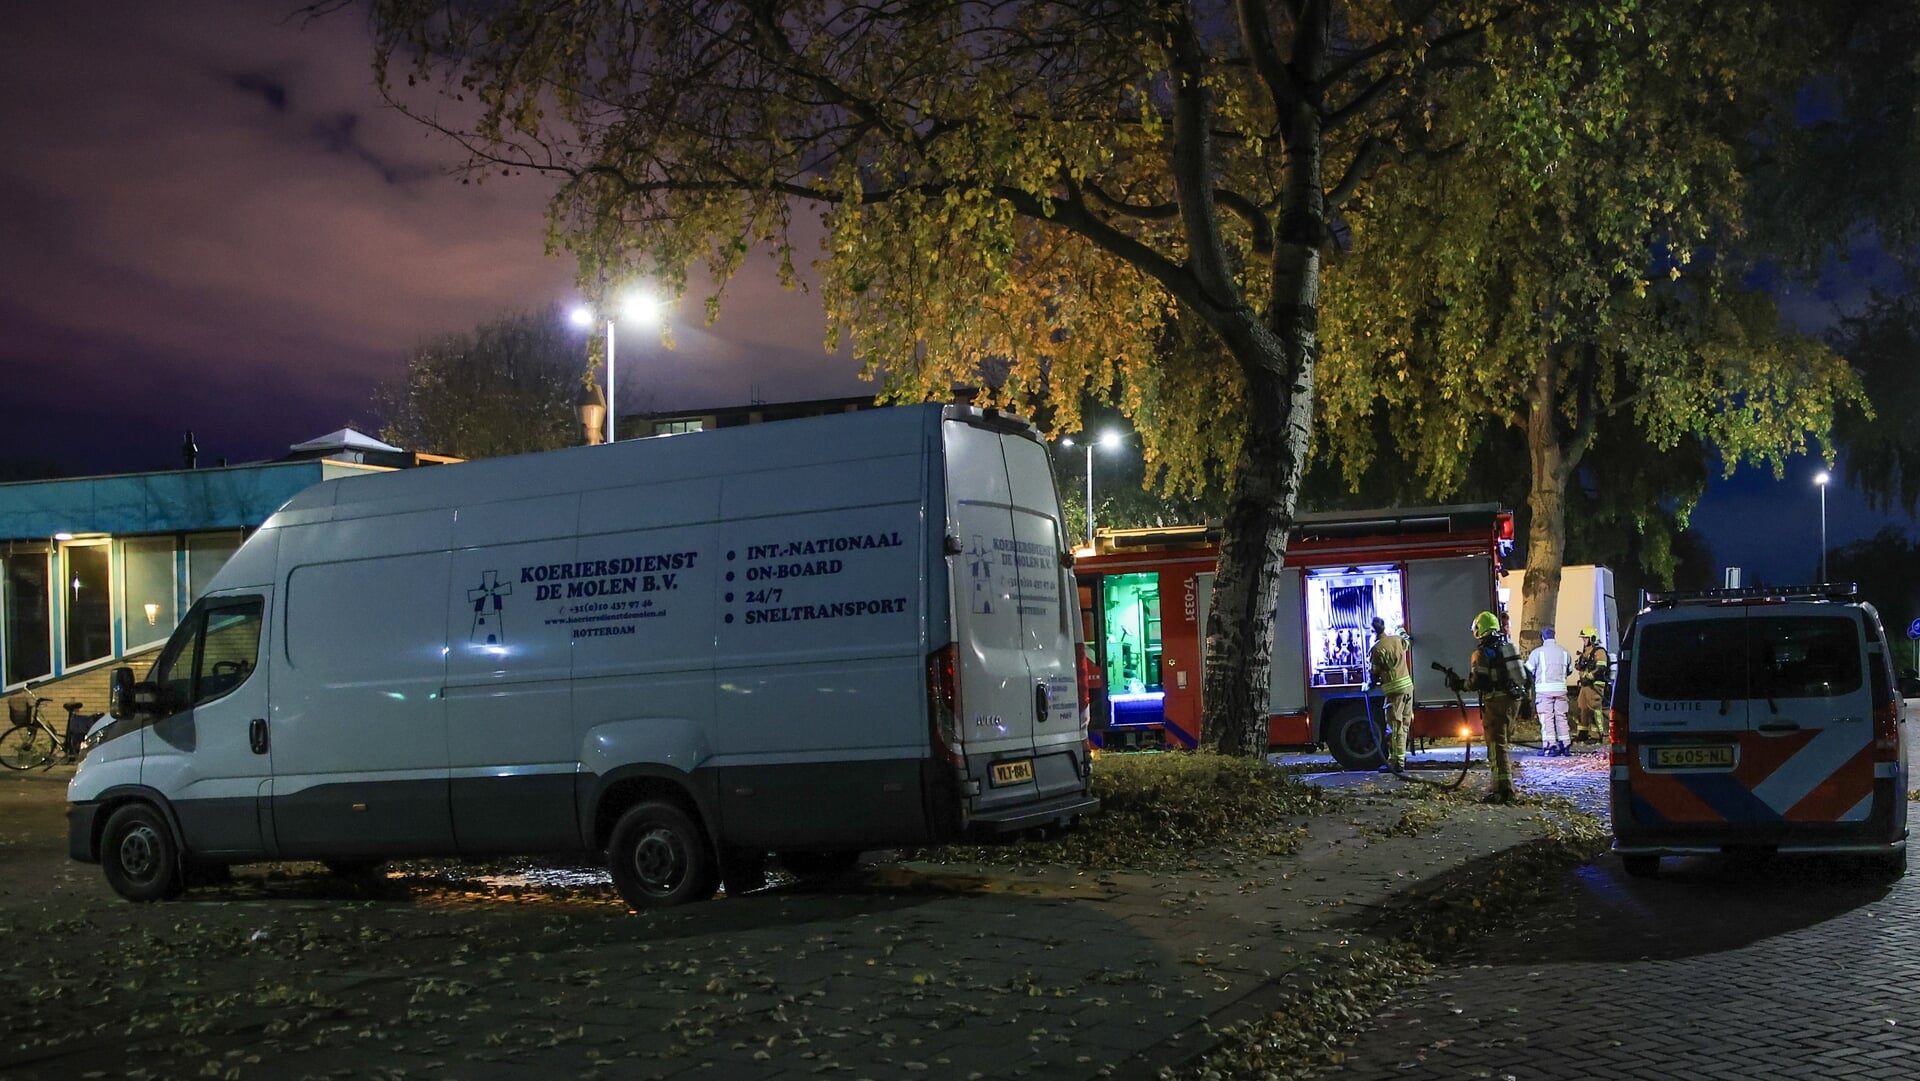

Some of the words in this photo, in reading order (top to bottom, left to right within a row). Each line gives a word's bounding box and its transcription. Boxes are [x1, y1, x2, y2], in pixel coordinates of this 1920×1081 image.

[747, 532, 903, 560] INT.-NATIONAAL
[520, 551, 698, 584] KOERIERSDIENST
[746, 560, 843, 581] ON-BOARD
[535, 583, 562, 601] DE
[567, 577, 637, 599] MOLEN
[642, 574, 678, 592] B.V.
[745, 587, 783, 604] 24/7
[1184, 577, 1196, 621] 17-0331
[745, 598, 907, 625] SNELTRANSPORT
[572, 626, 636, 638] ROTTERDAM
[1643, 702, 1703, 712] POLITIE
[1661, 749, 1729, 763] S-605-NL
